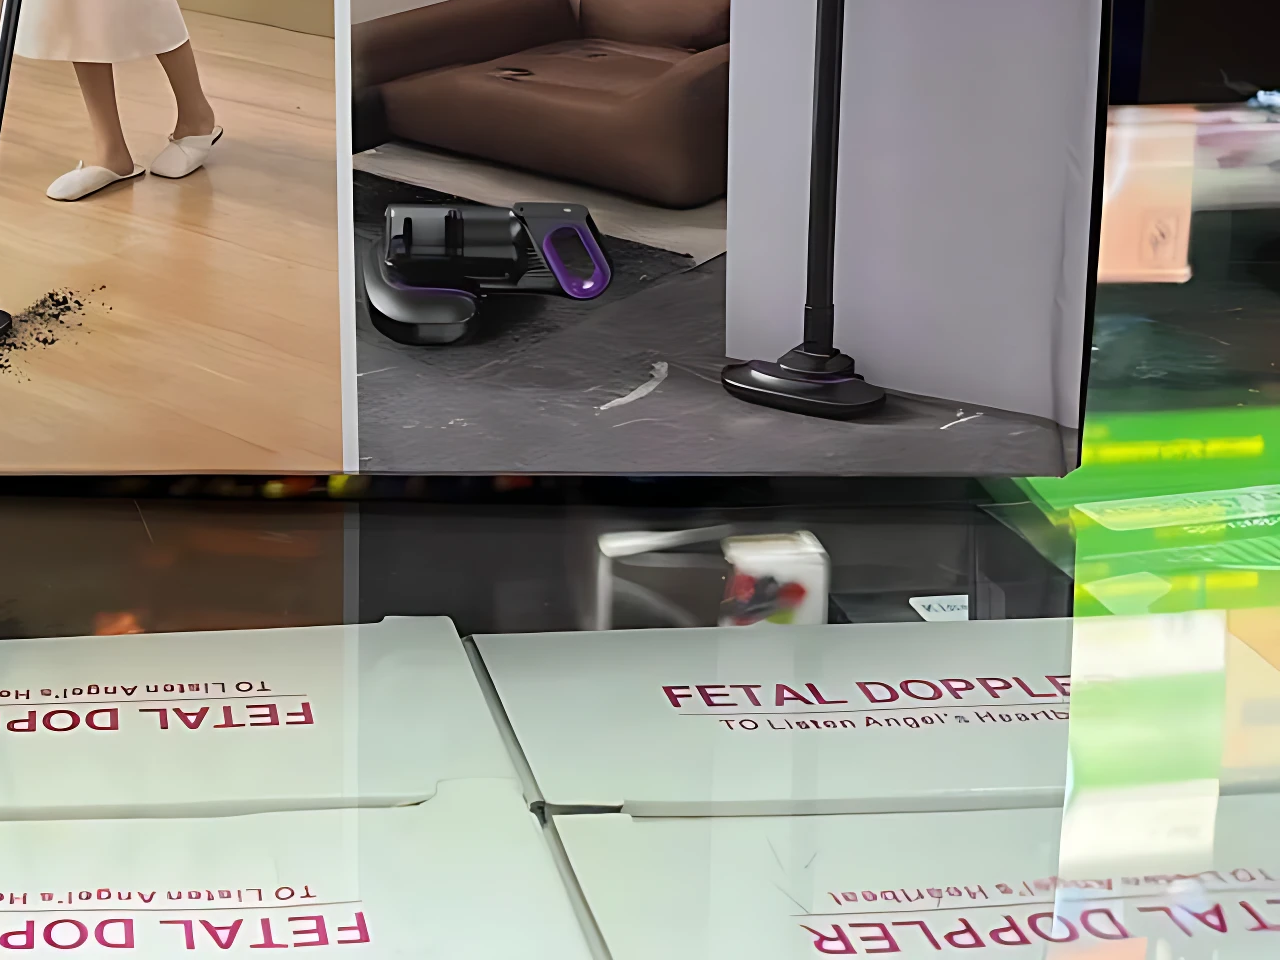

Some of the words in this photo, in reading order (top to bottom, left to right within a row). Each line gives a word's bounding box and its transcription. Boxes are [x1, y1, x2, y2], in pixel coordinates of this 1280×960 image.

[234, 680, 272, 693] TO
[661, 682, 849, 709] FETAL
[856, 674, 1072, 704] DOPPLE
[138, 701, 315, 730] FETAL
[719, 718, 761, 732] TO
[274, 885, 318, 901] TO
[159, 911, 372, 950] FETAL
[799, 908, 1132, 955] DOPPLER
[1137, 898, 1280, 938] TAL
